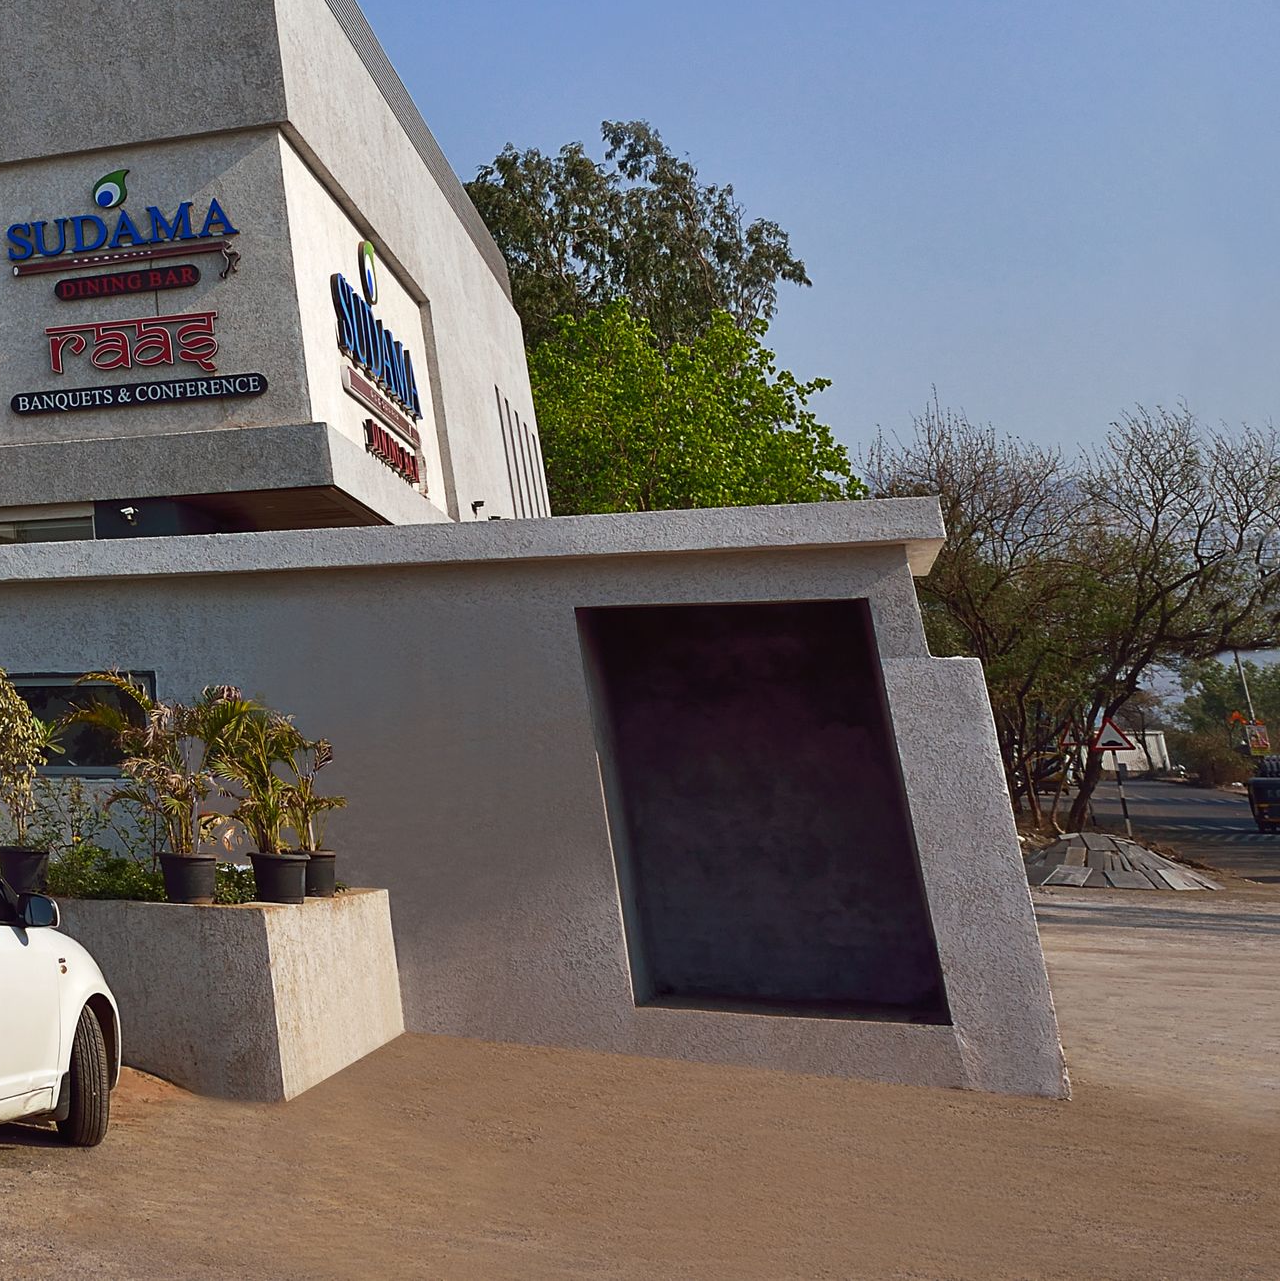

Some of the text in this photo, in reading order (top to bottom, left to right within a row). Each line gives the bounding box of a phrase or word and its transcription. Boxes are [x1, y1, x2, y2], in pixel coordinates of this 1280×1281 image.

[6, 197, 240, 262] SUDAMA
[61, 267, 197, 299] DINING BAR
[45, 311, 219, 374] raas
[331, 273, 424, 420] SUDAMA
[18, 376, 261, 411] BANQUETS & CONFERENCE
